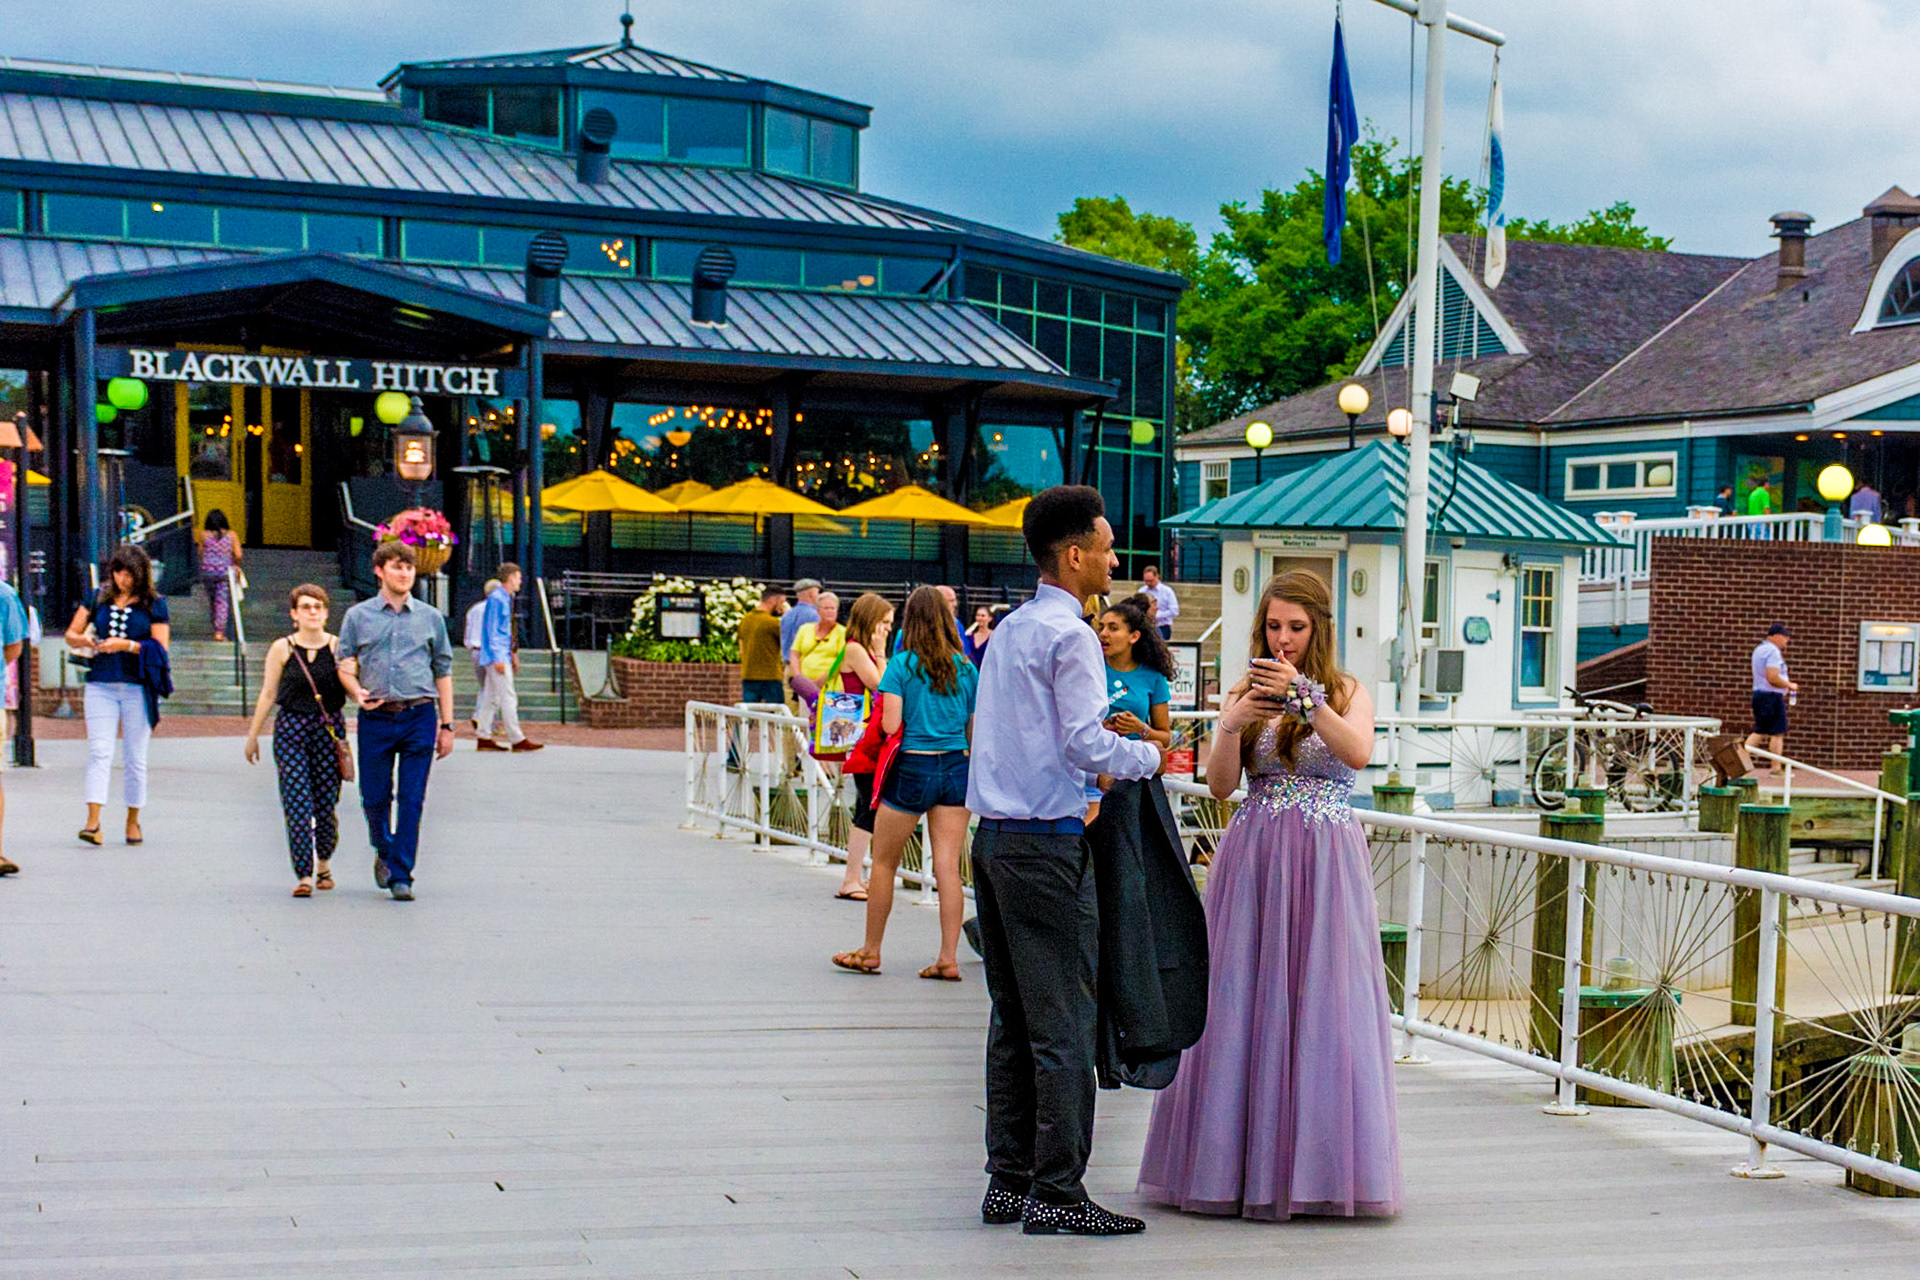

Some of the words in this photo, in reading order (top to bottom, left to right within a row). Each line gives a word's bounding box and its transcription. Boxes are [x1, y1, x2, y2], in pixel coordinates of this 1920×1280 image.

[129, 349, 360, 389] BLACKWALL
[372, 361, 499, 396] HITCH
[1175, 681, 1194, 693] CITY
